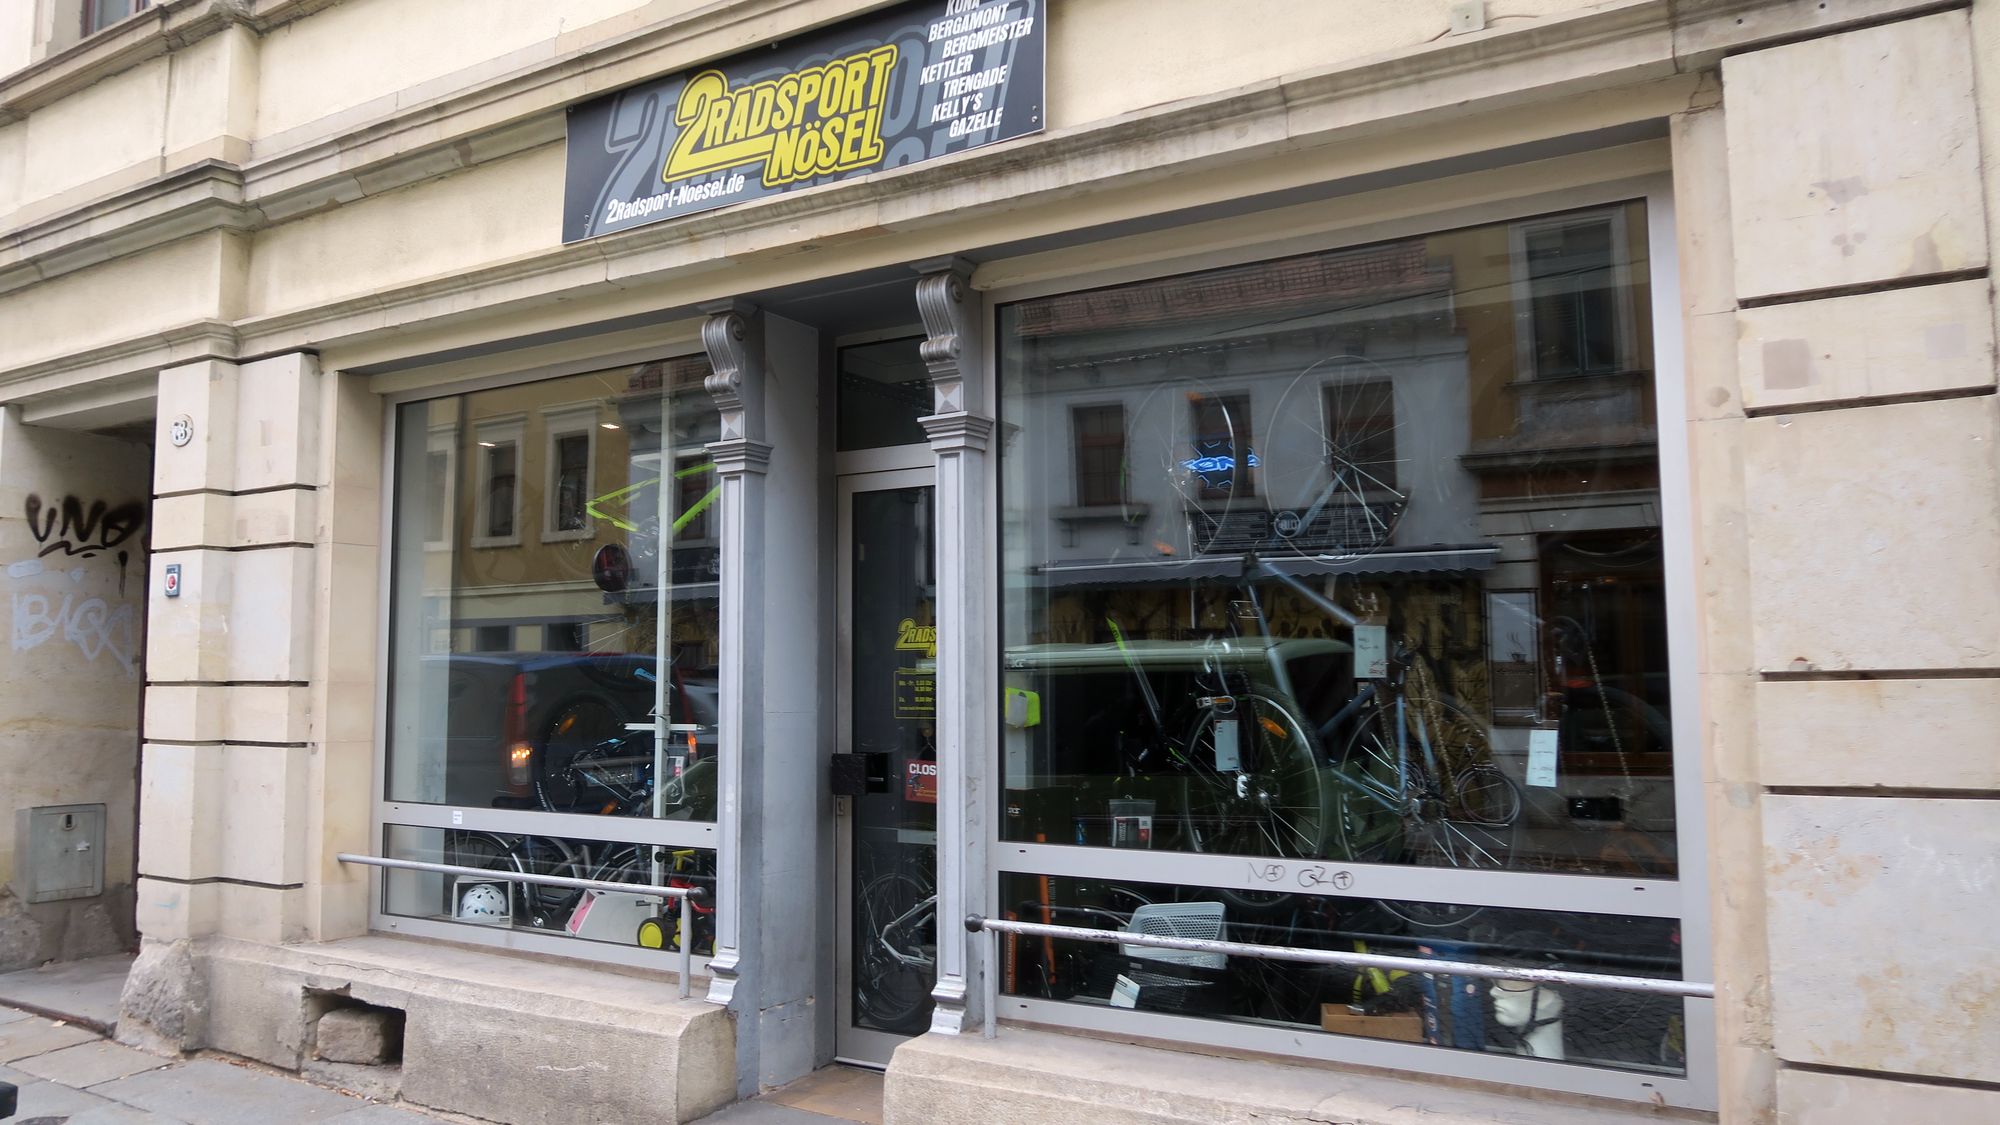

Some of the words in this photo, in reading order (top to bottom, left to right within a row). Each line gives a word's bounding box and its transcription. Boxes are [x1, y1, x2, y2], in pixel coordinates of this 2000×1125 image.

[928, 2, 1010, 43] BERGAMONT
[942, 17, 1034, 59] BERGMEISTER
[919, 54, 974, 86] KETTLER
[943, 64, 1008, 99] TRENGADE
[931, 92, 983, 123] KELLY'S
[949, 107, 1004, 138] GAZELLE
[767, 106, 879, 180] NÖSEL
[605, 173, 746, 225] 2Radsport-Noesel.de
